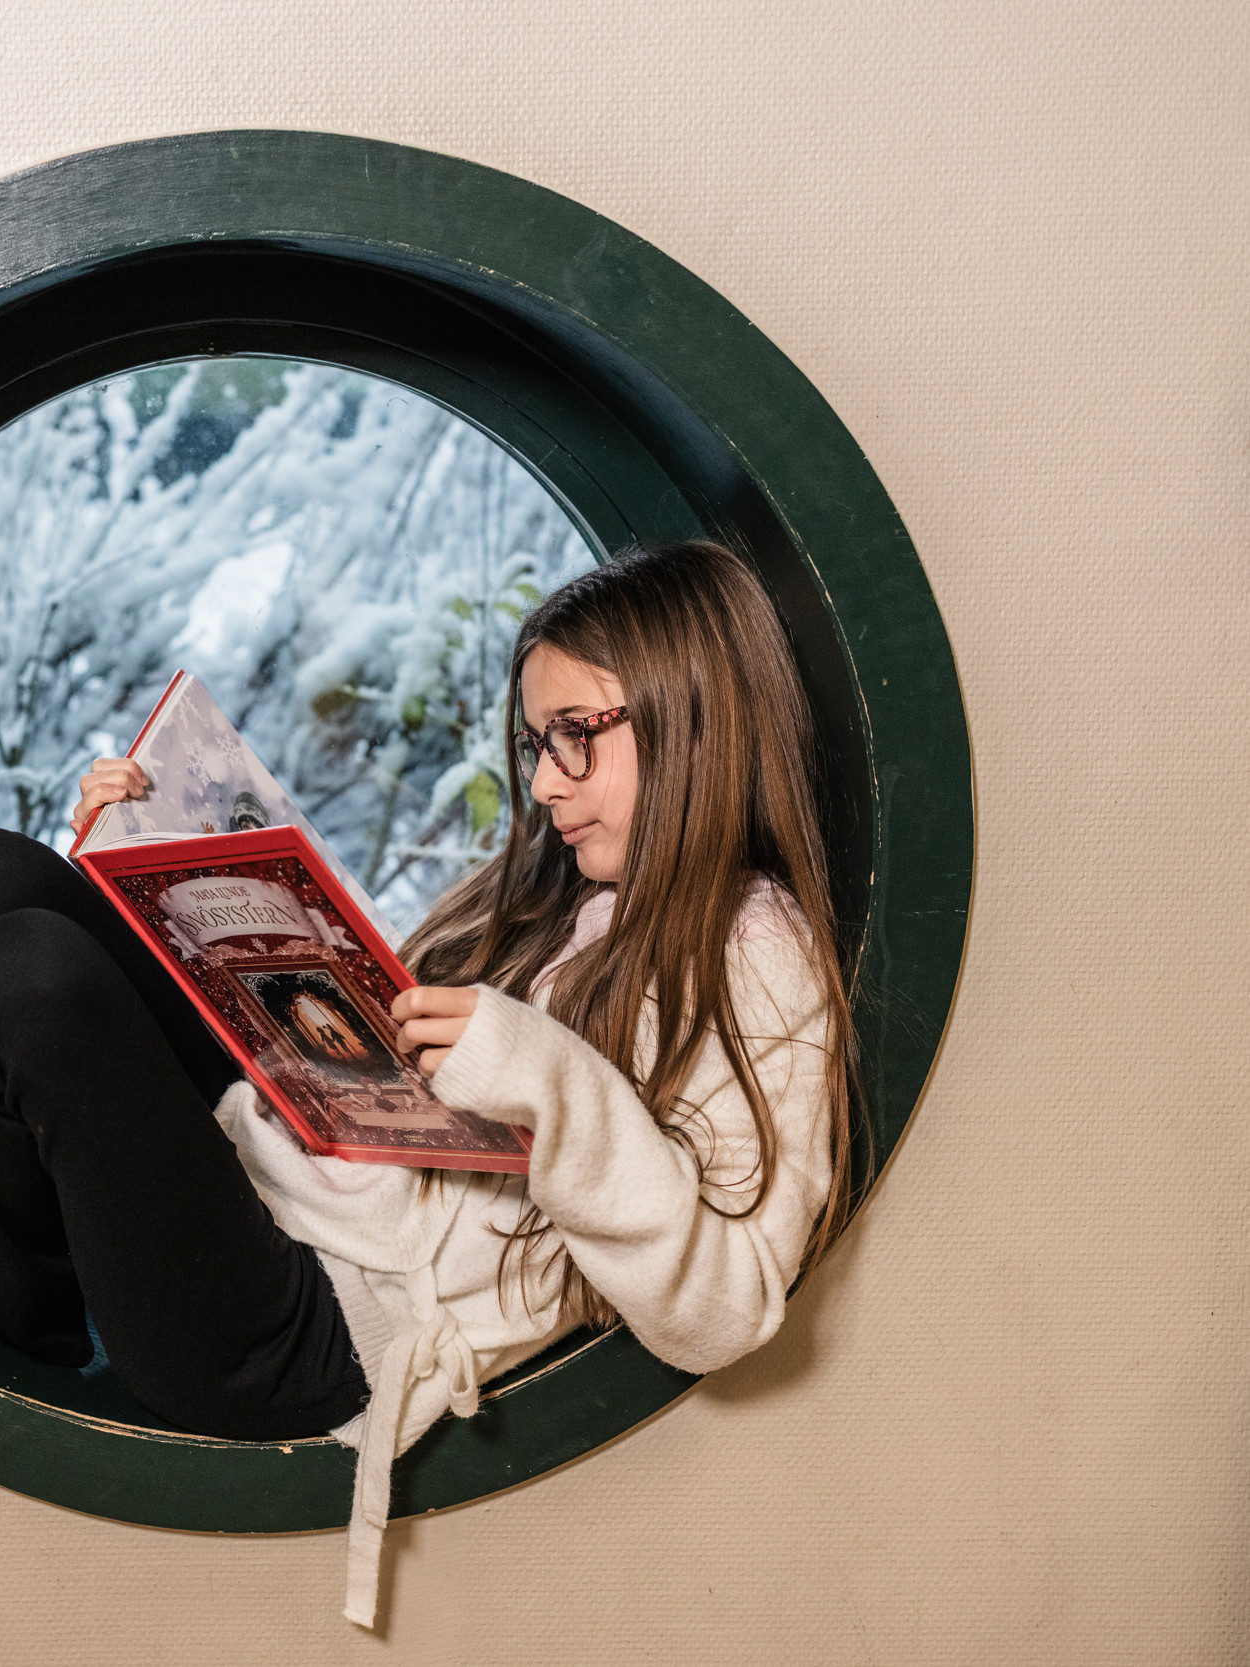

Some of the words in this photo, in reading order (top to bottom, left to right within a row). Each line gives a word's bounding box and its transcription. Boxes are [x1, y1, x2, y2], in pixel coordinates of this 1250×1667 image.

[189, 889, 219, 903] MAJA
[215, 885, 251, 900] LUNDE
[176, 900, 299, 936] SNÖSYSTERN
